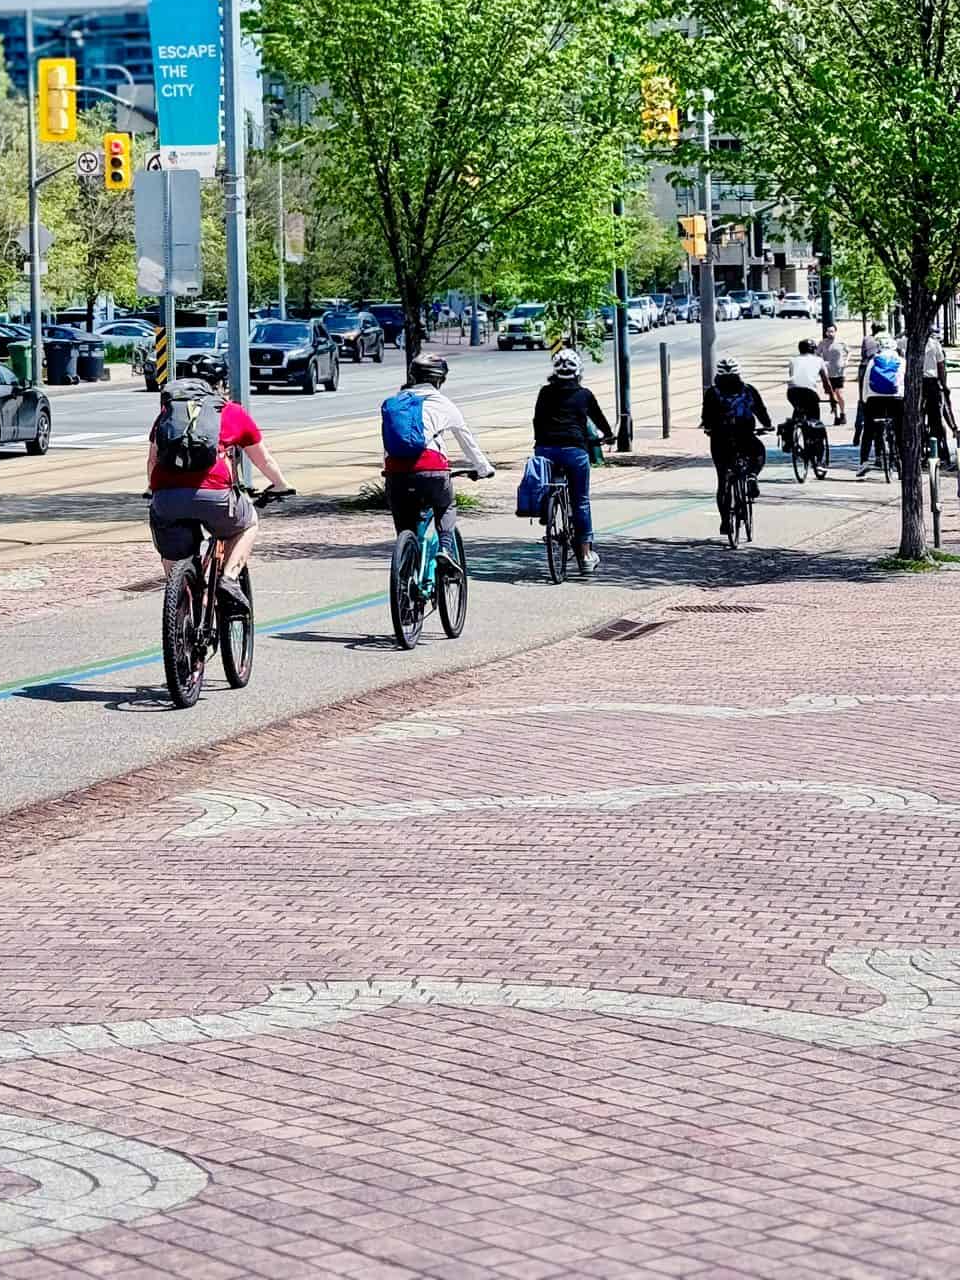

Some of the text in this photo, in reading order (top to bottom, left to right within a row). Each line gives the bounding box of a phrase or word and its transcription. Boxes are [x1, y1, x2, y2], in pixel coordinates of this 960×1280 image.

[158, 43, 217, 59] ESCAPE
[159, 64, 188, 79] THE
[161, 83, 195, 97] CITY
